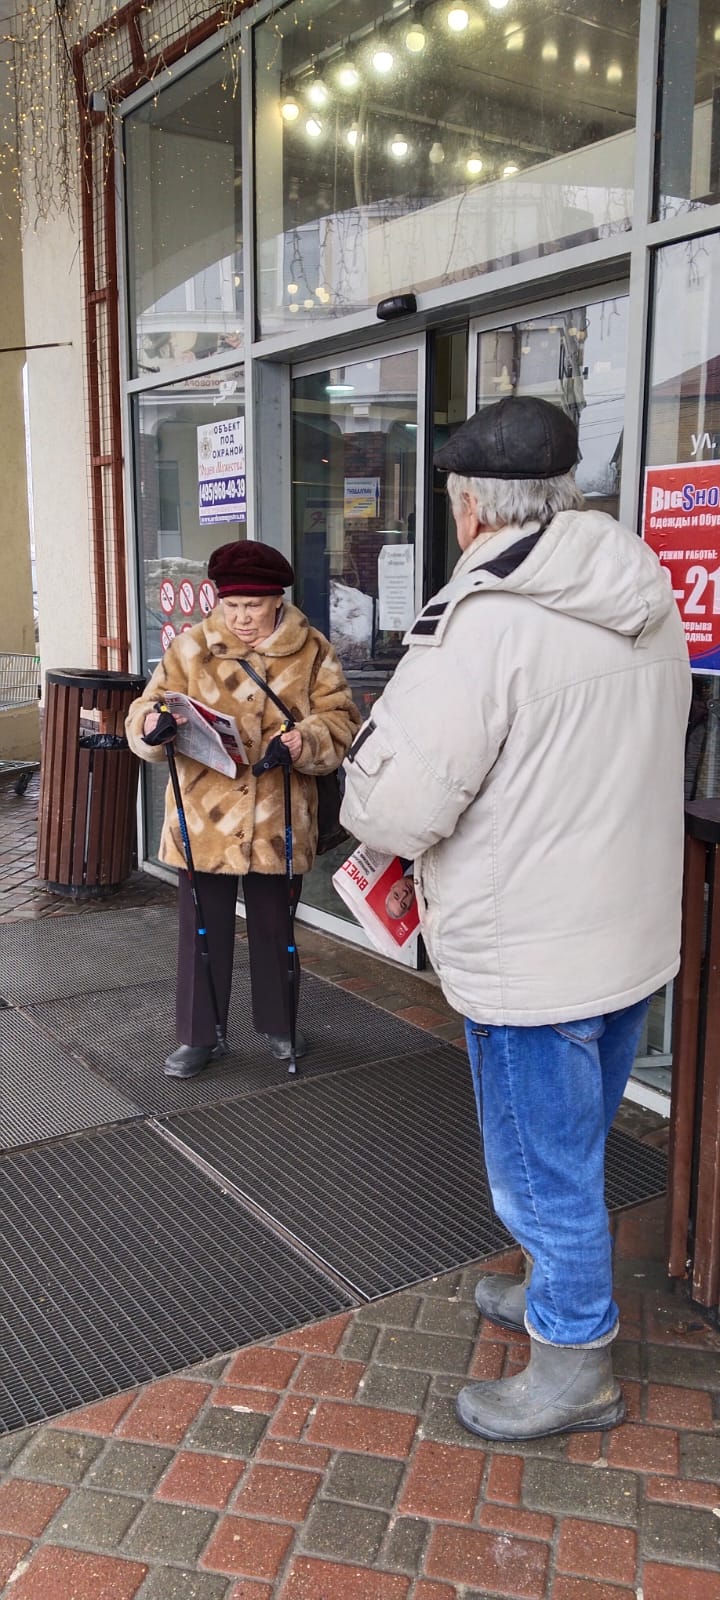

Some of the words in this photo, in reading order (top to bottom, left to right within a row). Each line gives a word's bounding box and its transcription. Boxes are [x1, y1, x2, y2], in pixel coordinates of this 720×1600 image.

[214, 421, 240, 434] ОБЪЕКТ
[220, 434, 234, 445] ПОД
[691, 433, 716, 456] ул.
[212, 443, 244, 459] ОХРАНОЙ
[650, 484, 720, 514] BIGSHO
[650, 515, 690, 529] Одежды
[691, 516, 698, 526] и
[659, 550, 684, 560] РЕЖИМ
[685, 549, 718, 560] РАБОТЫ:
[660, 565, 720, 615] -21
[684, 632, 712, 643] одных
